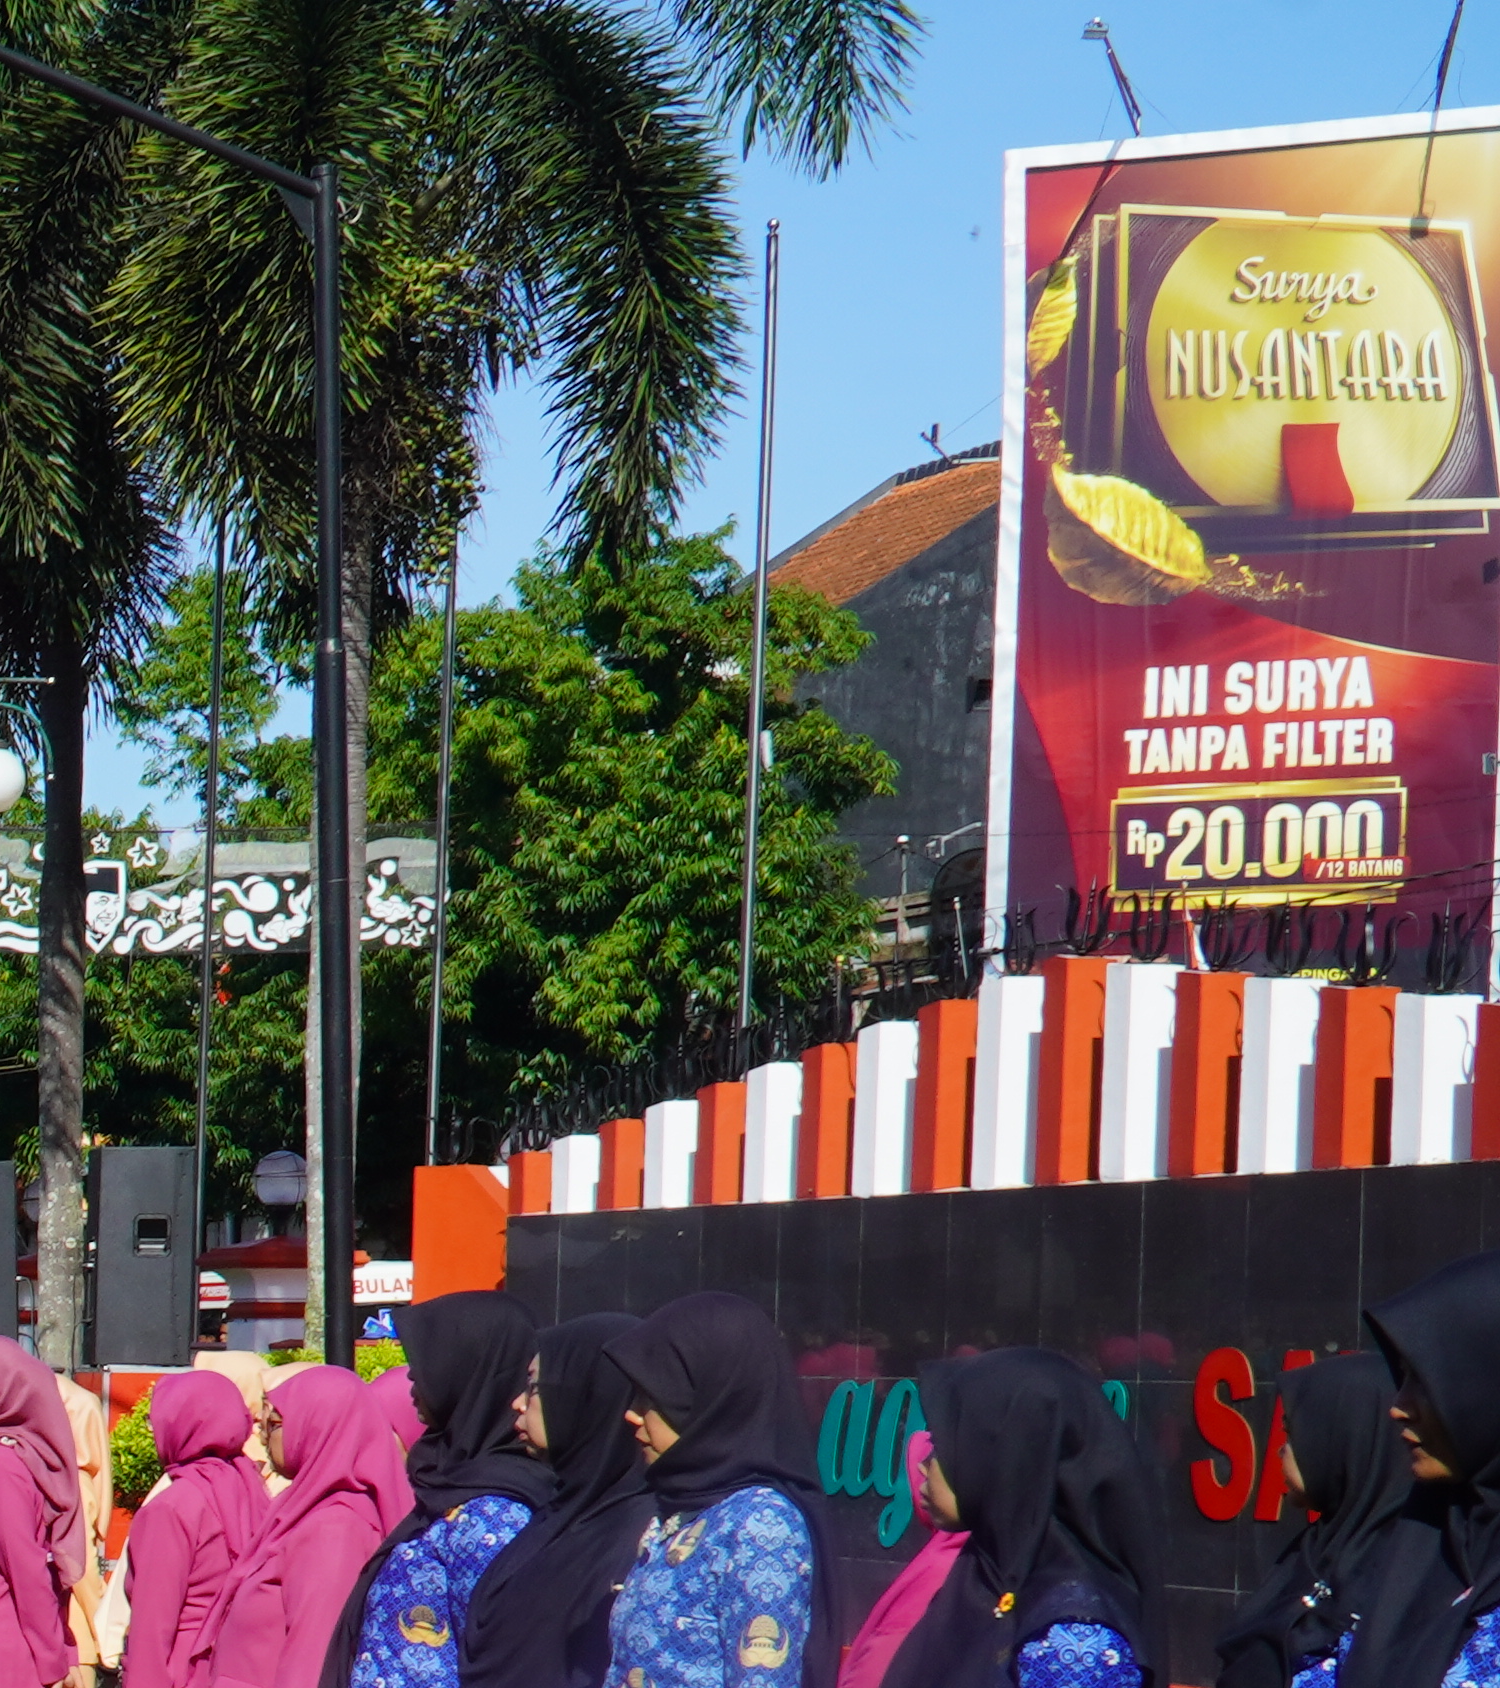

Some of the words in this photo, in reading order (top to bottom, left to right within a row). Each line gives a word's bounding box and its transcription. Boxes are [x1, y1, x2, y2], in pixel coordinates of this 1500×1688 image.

[1230, 256, 1379, 323] Surya
[1166, 327, 1449, 400] NUSANTARA
[1143, 664, 1209, 719] INI
[1223, 656, 1374, 716] SURYA
[1124, 724, 1250, 775] TANPA
[1262, 717, 1394, 769] FILTER
[1315, 861, 1344, 879] /12
[1347, 859, 1404, 878] BATANG
